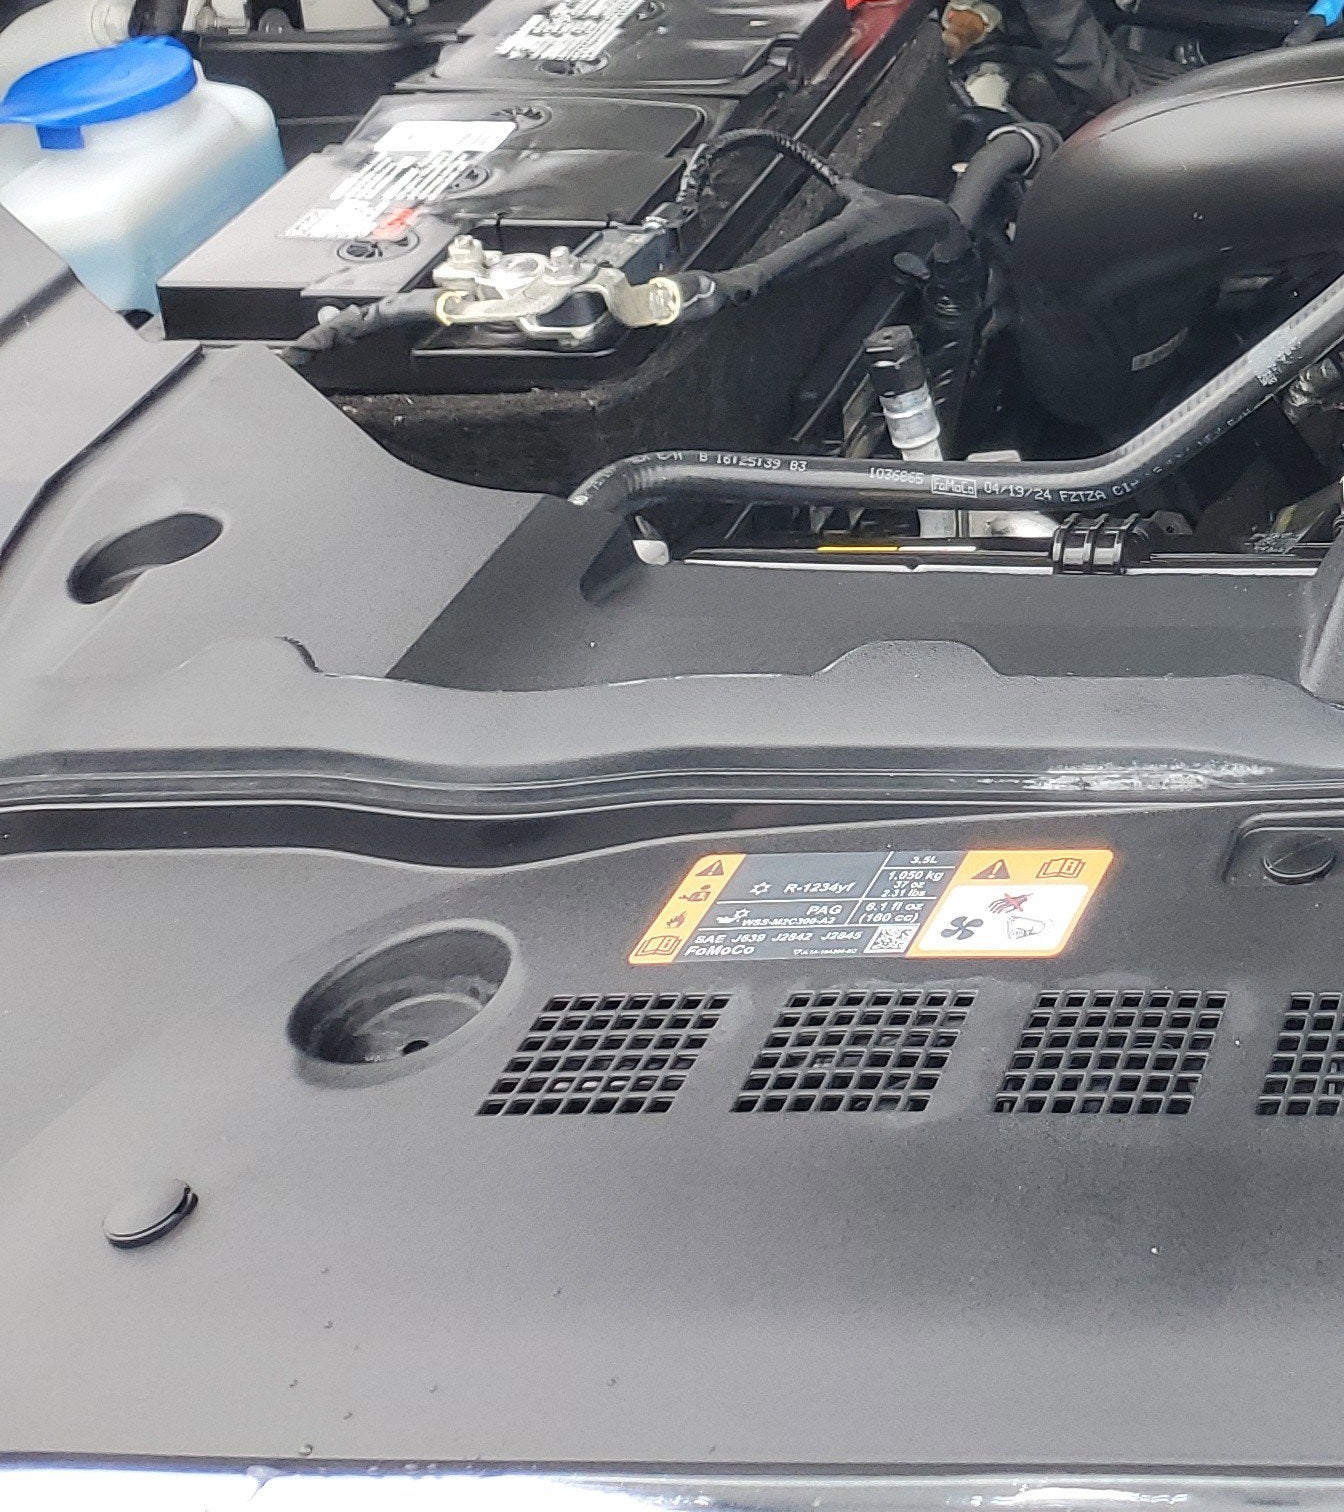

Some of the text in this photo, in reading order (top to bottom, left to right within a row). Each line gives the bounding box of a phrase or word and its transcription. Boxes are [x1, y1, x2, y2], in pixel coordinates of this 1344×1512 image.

[698, 452, 709, 463] B
[789, 459, 808, 473] B3
[868, 467, 925, 485] 1036865
[934, 477, 975, 495] FoMoCo
[984, 481, 1053, 502] 04/19/24
[910, 855, 938, 864] 3.5L
[888, 870, 945, 882] 1.050 kg
[783, 881, 856, 894] R-1234yf
[893, 880, 907, 888] 37
[881, 889, 926, 897] 2.31 lbs
[806, 904, 843, 915] PAG
[865, 901, 925, 912] 6.1 fl oz
[894, 911, 919, 923] cc)
[694, 934, 727, 944] SAE
[684, 944, 756, 957] FoMoCo
